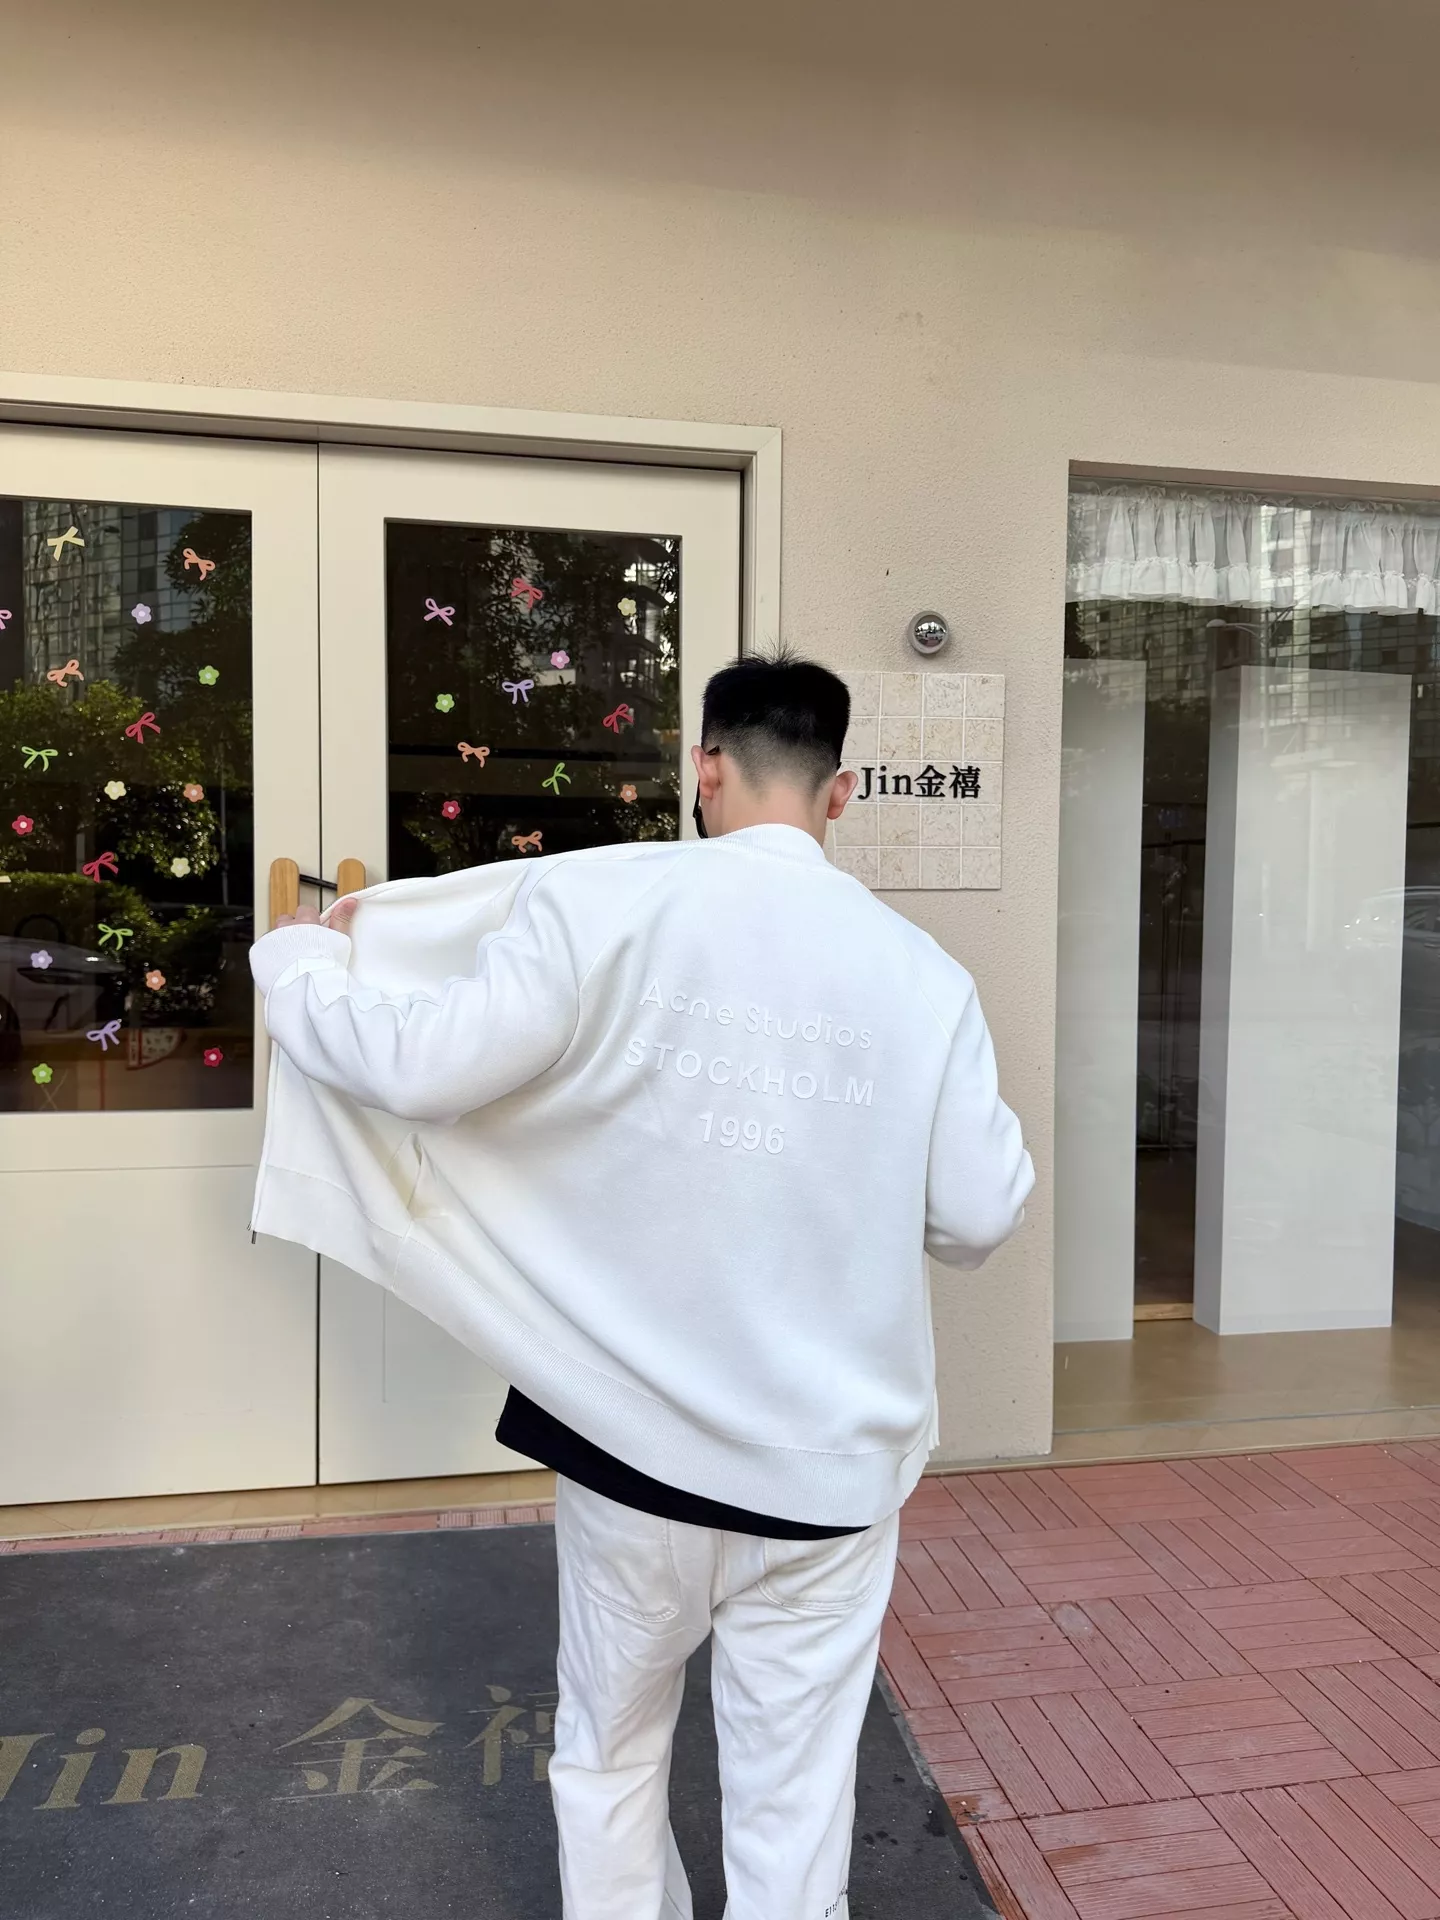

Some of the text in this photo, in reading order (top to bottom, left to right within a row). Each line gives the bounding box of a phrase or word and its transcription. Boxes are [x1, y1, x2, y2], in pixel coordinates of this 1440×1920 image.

[639, 977, 873, 1050] Acne Studios
[623, 1037, 875, 1107] STOCKHOLM
[699, 1110, 786, 1155] 1996
